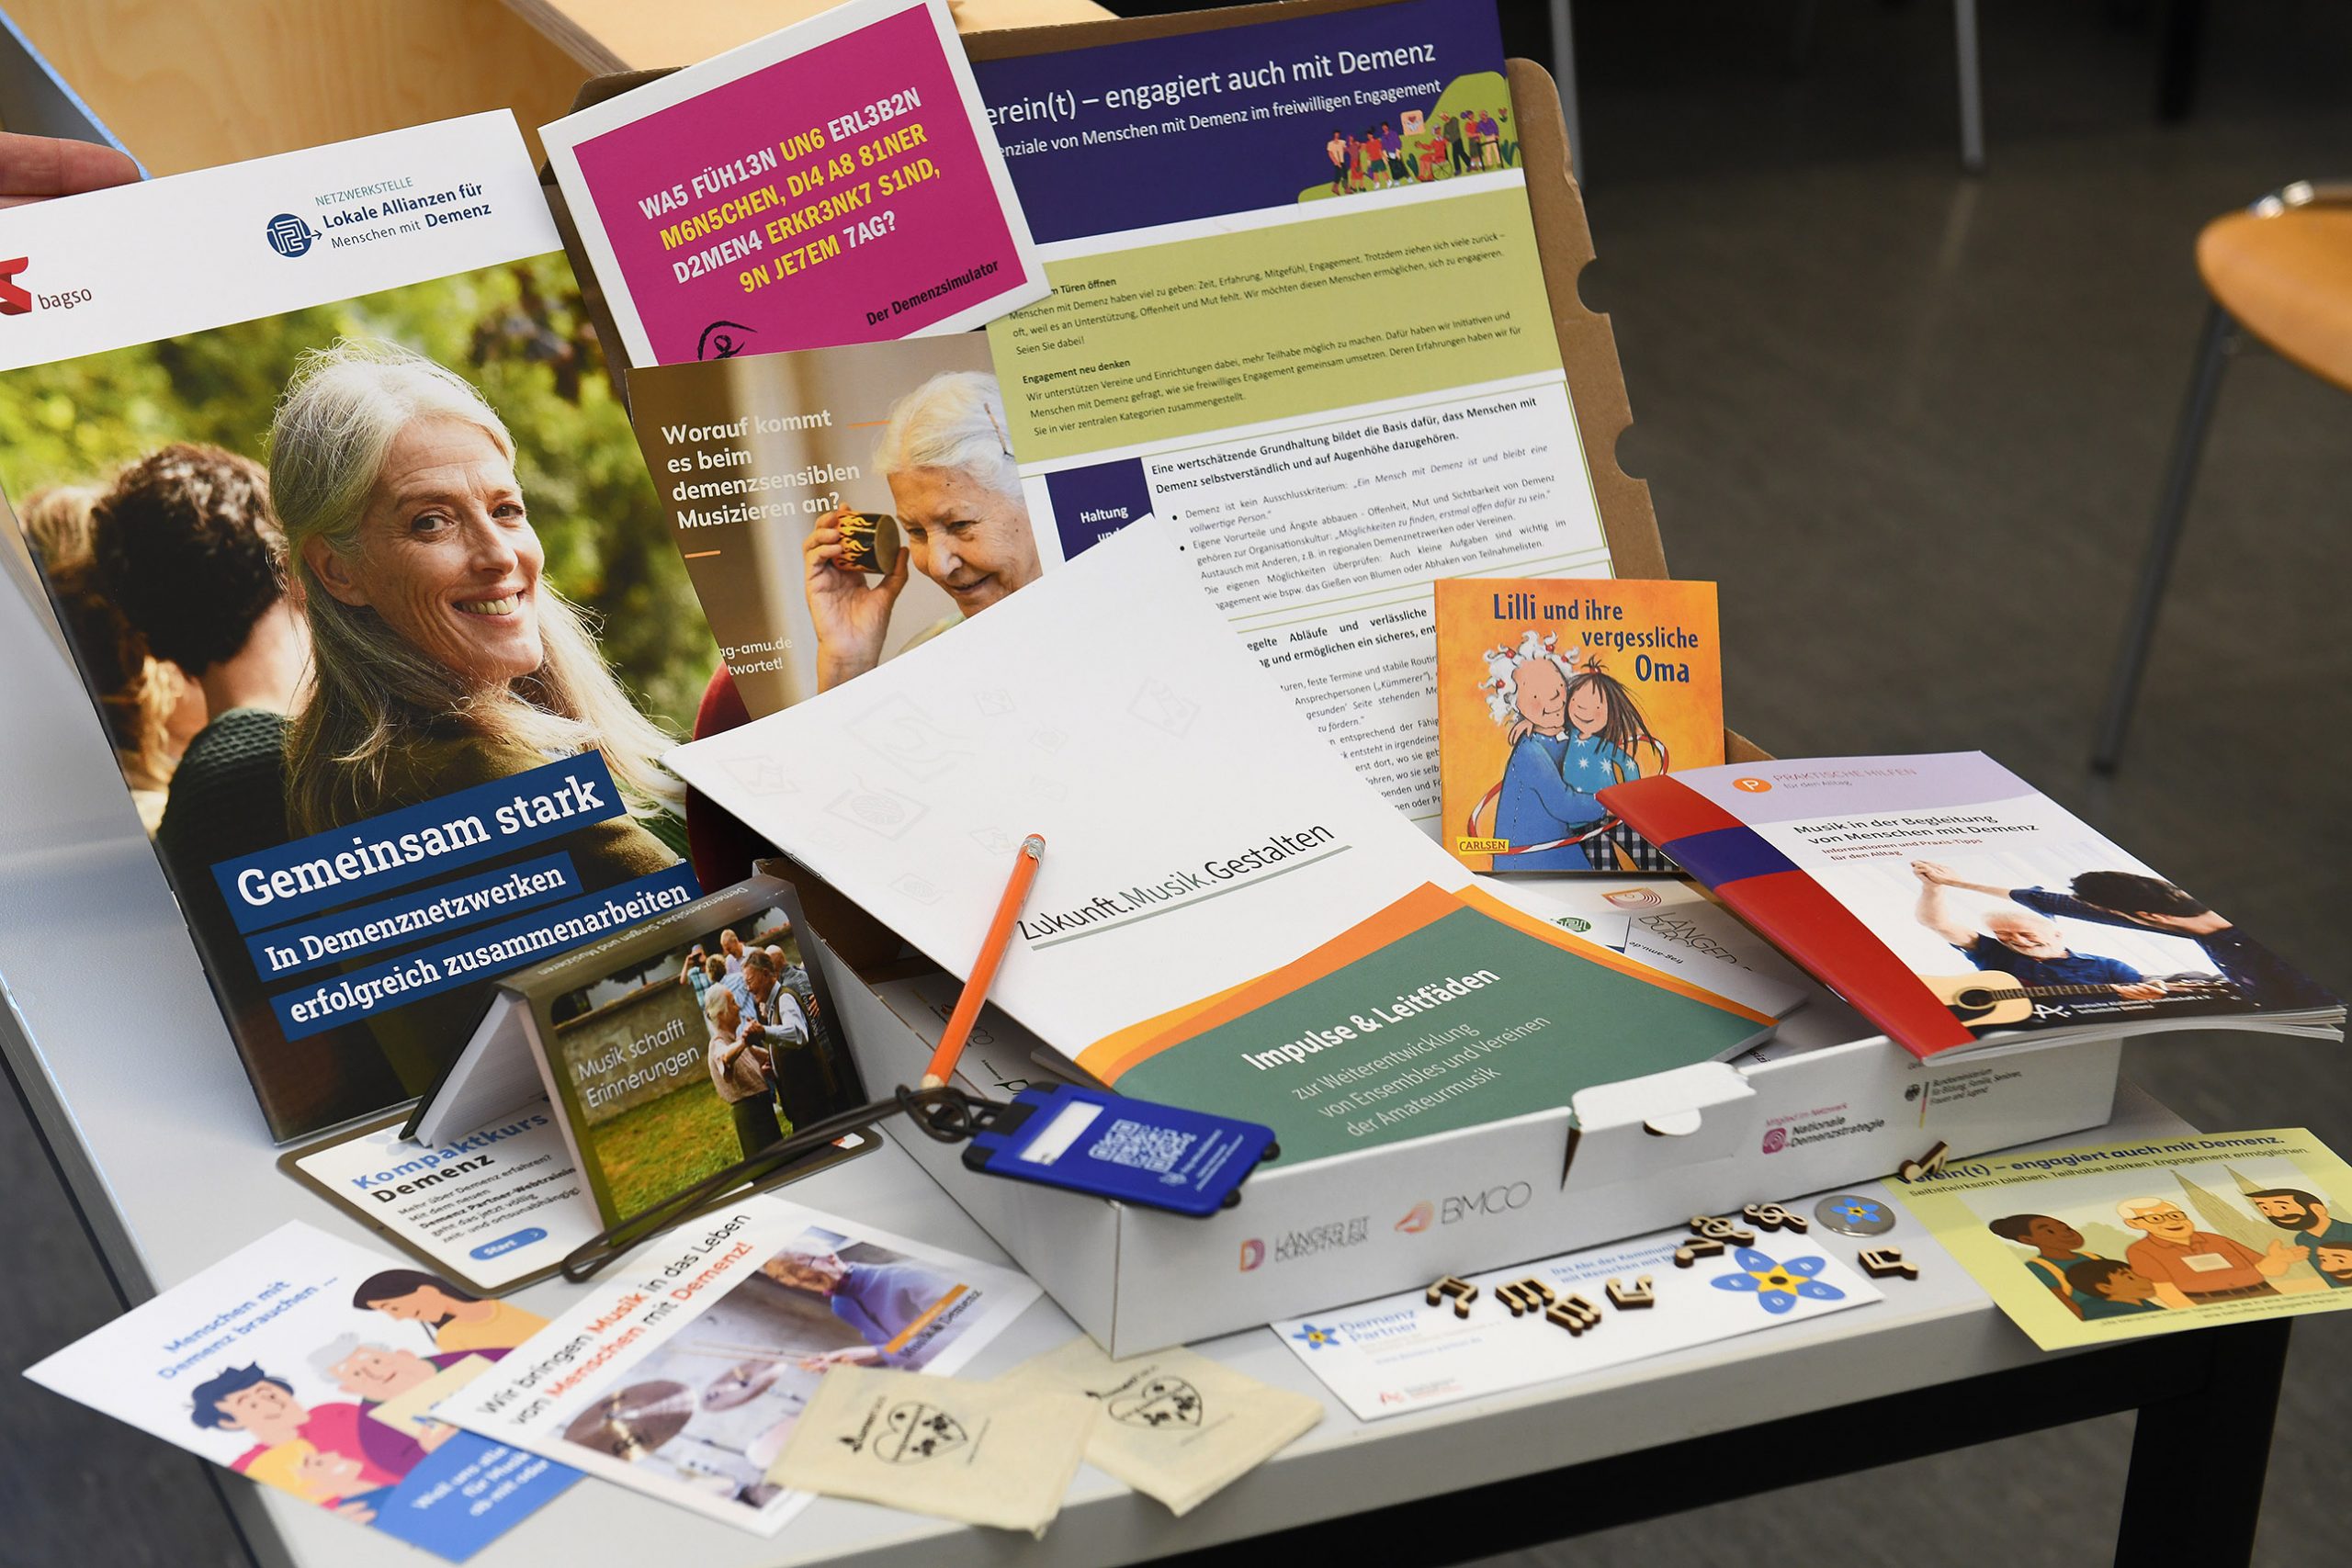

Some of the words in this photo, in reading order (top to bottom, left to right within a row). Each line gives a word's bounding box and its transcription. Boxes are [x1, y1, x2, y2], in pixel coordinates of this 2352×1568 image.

[984, 90, 1075, 126] erein(t)
[1105, 72, 1222, 109] engagiert
[1227, 61, 1285, 91] auch
[1292, 54, 1333, 81] mit
[1338, 43, 1436, 74] Demenz
[1000, 138, 1047, 159] enziale
[1050, 136, 1079, 150] von
[1081, 123, 1159, 145] Menschen
[1160, 117, 1186, 133] mit
[1189, 110, 1249, 130] Demenz
[1250, 106, 1270, 120] im
[1272, 95, 1351, 117] freiwilligen
[1353, 80, 1442, 106] Engagement
[638, 184, 688, 220] WA5
[691, 147, 777, 198] FÜH13N
[779, 128, 825, 162] UN6
[827, 86, 922, 143] ERL3B2N
[314, 176, 413, 206] NETZWERKSTELLE
[322, 206, 379, 229] Lokale
[382, 190, 457, 216] Allianzen
[458, 183, 481, 198] für
[660, 186, 786, 251] M6N5CHEN,
[786, 164, 825, 197] DI4
[828, 154, 855, 183] A8
[858, 122, 928, 170] 81NER
[331, 227, 396, 249] Menschen
[399, 220, 421, 233] mit
[424, 204, 492, 228] Demenz
[672, 230, 763, 285] D2MEN4
[765, 181, 873, 245] ERKR3NK7
[877, 157, 940, 197] S1ND,
[739, 264, 770, 293] 9N
[774, 234, 841, 280] JE7EM
[842, 210, 896, 249] 7AG?
[37, 288, 92, 310] bagso
[865, 307, 889, 327] Der
[891, 259, 999, 316] Demenzsimulator
[1060, 282, 1085, 293] Türen
[1087, 278, 1116, 290] öffnen
[1016, 344, 1040, 355] Seien
[1041, 341, 1055, 351] Sie
[1057, 336, 1085, 348] dabei!
[1022, 367, 1078, 384] Engagement
[1079, 366, 1096, 374] neu
[1097, 360, 1131, 371] denken
[662, 418, 748, 446] Worauf
[754, 410, 832, 434] kommt
[1034, 426, 1047, 436] Sie
[1048, 424, 1057, 434] in
[1058, 423, 1075, 432] vier
[1078, 415, 1117, 429] zentralen
[1117, 407, 1166, 423] Kategorien
[1167, 392, 1245, 413] zusammengestellt.
[1151, 464, 1173, 475] Eine
[1176, 448, 1257, 470] wertschätzende
[1260, 436, 1330, 456] Grundhaltung
[1331, 429, 1361, 442] bildet
[1363, 426, 1379, 436] die
[1382, 421, 1408, 434] Basis
[1410, 416, 1440, 428] dafür,
[1442, 412, 1464, 423] dass
[1466, 402, 1517, 417] Menschen
[1520, 397, 1537, 408] mit
[667, 457, 692, 473] es
[696, 447, 752, 470] beim
[1155, 479, 1198, 494] Demenz
[1200, 461, 1291, 486] selbstverständlich
[1292, 457, 1312, 468] und
[1315, 453, 1330, 465] auf
[1333, 444, 1389, 461] Augenhöhe
[1392, 433, 1458, 451] dazugehören.
[672, 464, 860, 502] demenzsensiblen
[677, 501, 796, 530] Musizieren
[803, 491, 840, 513] an?
[1080, 506, 1129, 524] Haltung
[1493, 593, 1536, 620] Lilli
[1544, 600, 1578, 620] und
[1585, 600, 1623, 620] ihre
[1581, 626, 1699, 651] vergessliche
[728, 657, 784, 676] twortet!
[1635, 654, 1690, 682] Oma
[1773, 771, 1861, 783] PRAKTISCHE
[1865, 768, 1917, 778] HILFEN
[237, 816, 492, 907] Gemeinsam
[495, 775, 605, 834] stark
[1459, 840, 1507, 852] CARLSEN
[1793, 823, 1845, 835] Musik
[1849, 820, 1868, 830] in
[1871, 818, 1898, 829] der
[1899, 814, 1998, 827] Begleitung
[1807, 835, 1844, 846] von
[1846, 827, 1936, 842] Menschen
[1936, 826, 1967, 836] mit
[1967, 822, 2040, 834] Demenz
[1822, 842, 1898, 855] Informationen
[1899, 840, 1920, 849] und
[1919, 837, 1984, 848] Praxis-Tipps
[1870, 850, 1903, 859] Alltag
[264, 947, 301, 971] In
[300, 868, 566, 961] Demenznetzwerken
[290, 959, 441, 1023] erfolgreich
[443, 885, 691, 976] zusammenarbeiten
[1241, 1023, 1358, 1071] Impulse
[1350, 1014, 1384, 1033] &
[1372, 969, 1500, 1024] Leitfäden
[579, 1045, 627, 1080] Musik
[629, 1019, 685, 1058] schafft
[1292, 1085, 1323, 1101] zur
[1317, 1022, 1480, 1094] Weiterentwicklung
[1318, 1101, 1356, 1119] von
[1350, 1063, 1447, 1106] Ensembles
[1442, 1046, 1480, 1069] und
[1469, 1014, 1551, 1054] Vereinen
[586, 1048, 699, 1108] Erinnerungen
[1346, 1117, 1380, 1137] der
[1378, 1066, 1502, 1127] Amateurmusik
[1792, 1115, 1846, 1136] Nationale
[353, 1114, 549, 1190] Kompaktkurs
[2010, 1151, 2108, 1170] engagiert
[2112, 1145, 2162, 1158] auch
[2164, 1142, 2199, 1153] mit
[2199, 1136, 2285, 1149] Demenz.
[371, 1154, 495, 1202] Demenz
[1441, 1181, 1532, 1225] BMCO
[483, 1240, 518, 1256] Start
[157, 1335, 236, 1378] Demenz
[232, 1285, 320, 1335] brauchen
[164, 1301, 257, 1352] Menschen
[257, 1281, 290, 1301] mit
[476, 1387, 520, 1415] Wir
[512, 1333, 594, 1389] bringen
[586, 1290, 650, 1336] Musik
[645, 1276, 668, 1294] in
[663, 1252, 699, 1280] das
[690, 1213, 752, 1256] Leben
[509, 1397, 551, 1426] von
[543, 1325, 647, 1399] Menschen
[642, 1300, 680, 1327] mit
[670, 1242, 755, 1303] Demenz!
[1340, 1310, 1417, 1331] Demenz
[1350, 1321, 1417, 1342] Partner
